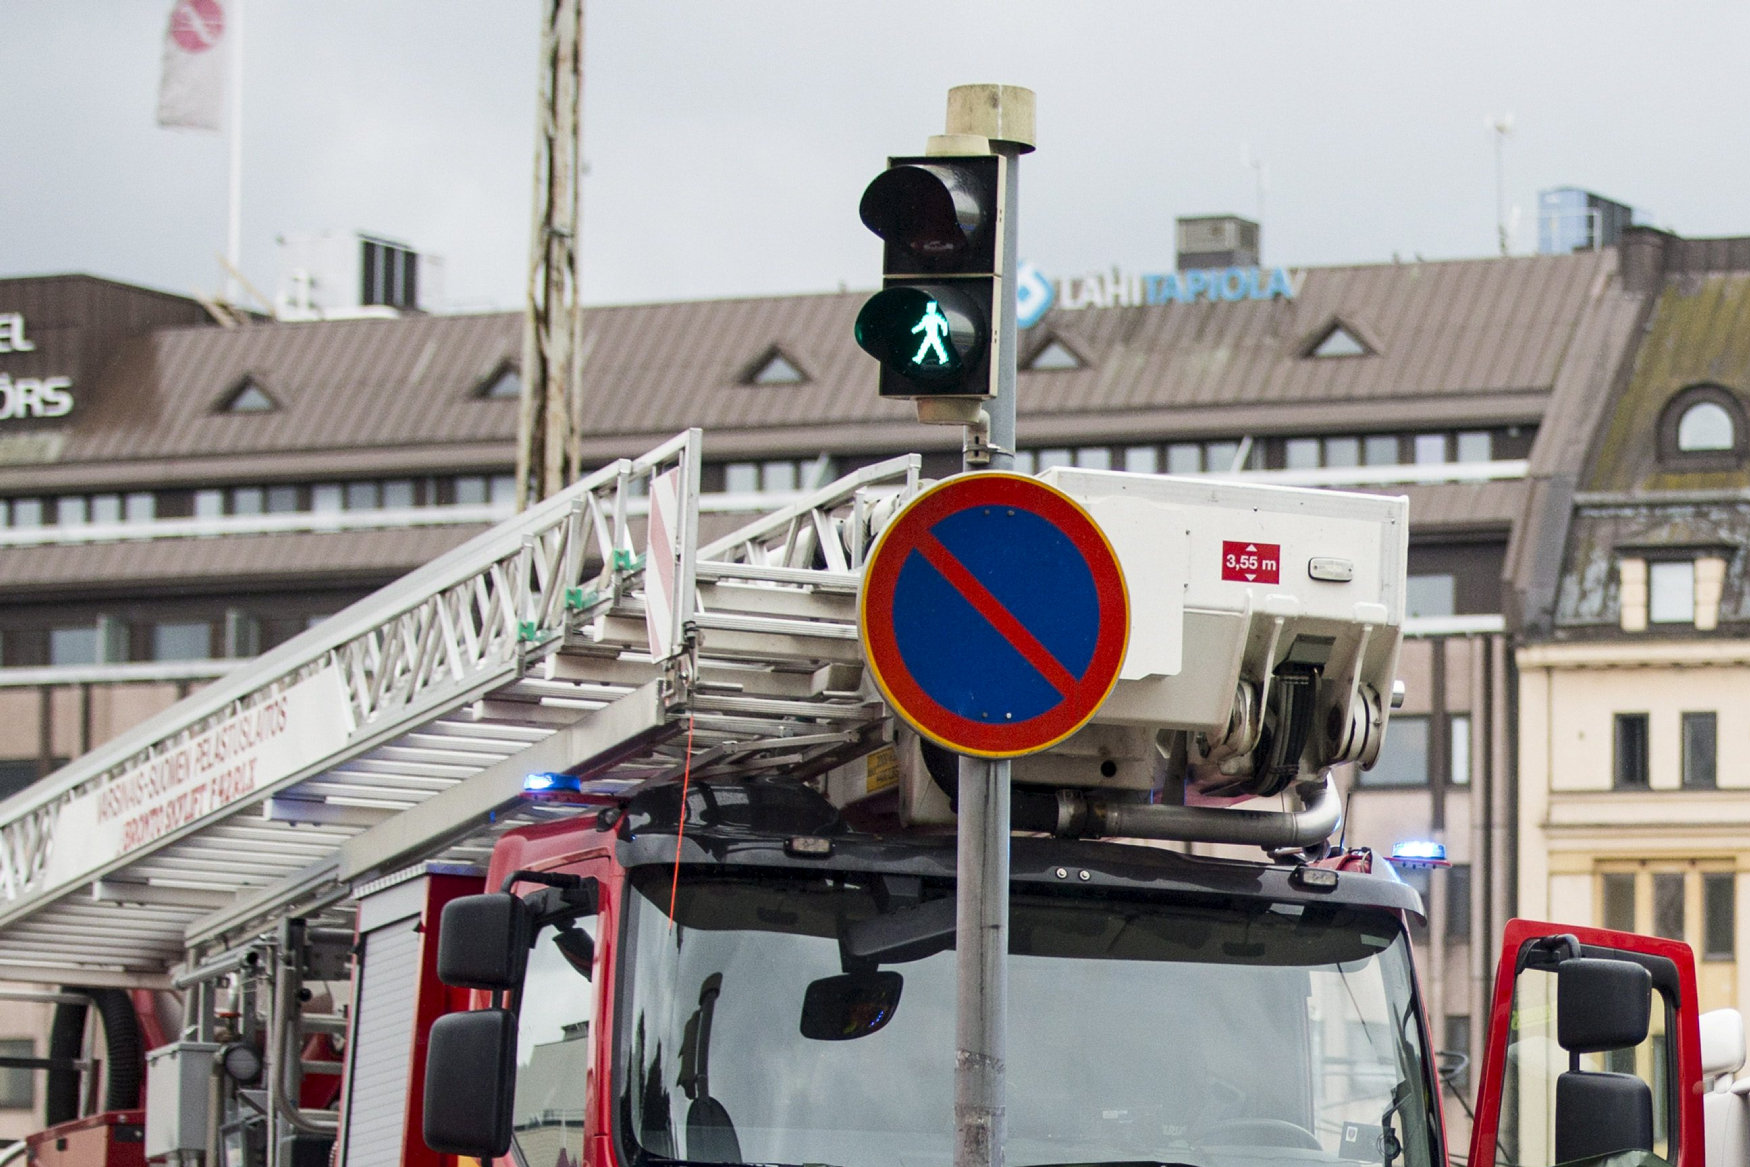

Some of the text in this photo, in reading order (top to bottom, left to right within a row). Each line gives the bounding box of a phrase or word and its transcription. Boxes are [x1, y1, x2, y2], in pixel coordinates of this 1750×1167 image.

[1057, 265, 1296, 310] LAHITAPIOLA
[1226, 553, 1276, 571] 3,55 m
